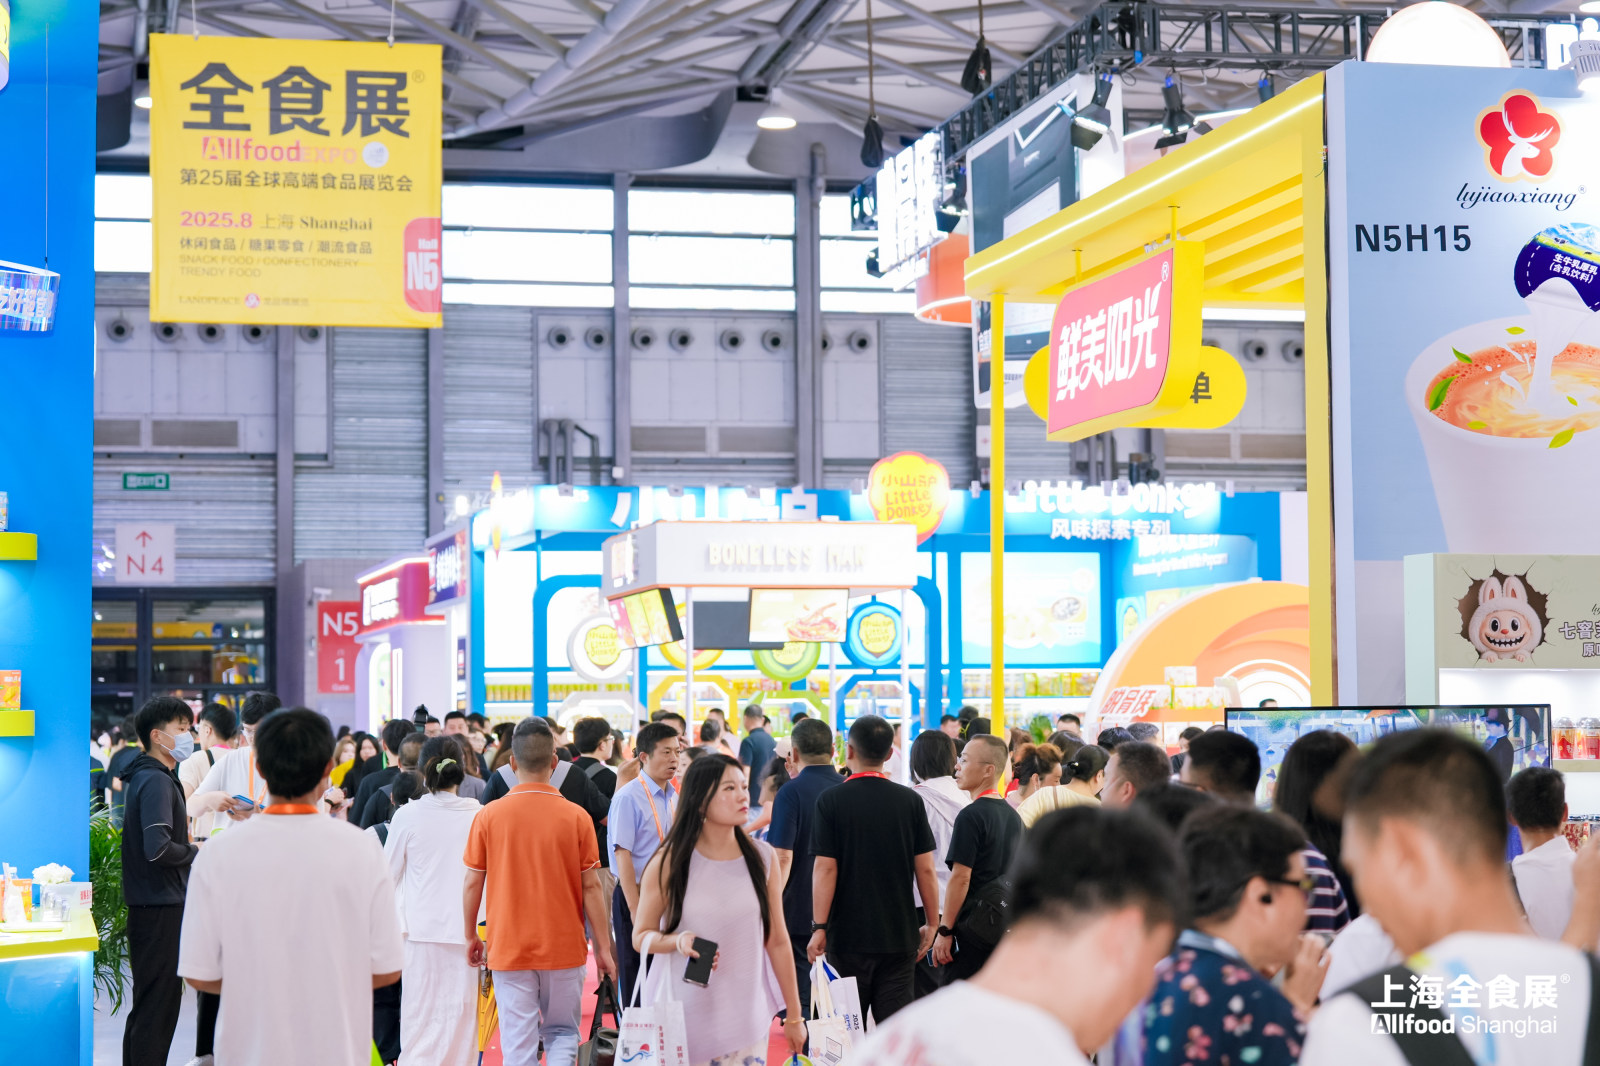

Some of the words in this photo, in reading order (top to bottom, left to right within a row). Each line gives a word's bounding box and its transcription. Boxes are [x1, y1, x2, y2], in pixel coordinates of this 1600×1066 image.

[180, 62, 410, 139] 全食展
[179, 168, 413, 192] 第25届全球高端食品展览会
[1456, 182, 1577, 211] lujiaoxiang
[179, 210, 253, 228] 2025.8
[260, 213, 294, 231] 上海
[300, 216, 373, 232] Shanghai
[180, 237, 236, 250] 休闲食品
[418, 238, 438, 249] Hall
[1355, 223, 1471, 252] N5H15
[179, 254, 218, 265] SNACK
[221, 255, 254, 265] FOOD
[263, 256, 359, 268] CONFECTIONERY
[179, 266, 225, 276] TRENDY
[229, 267, 261, 278] FOOD
[407, 251, 439, 291] N5
[1055, 281, 1163, 402] 鲜美阳光
[127, 554, 164, 576] N4
[708, 543, 812, 567] BONELESS
[826, 544, 865, 567] MAN
[322, 611, 359, 637] N5
[334, 657, 345, 682] 1
